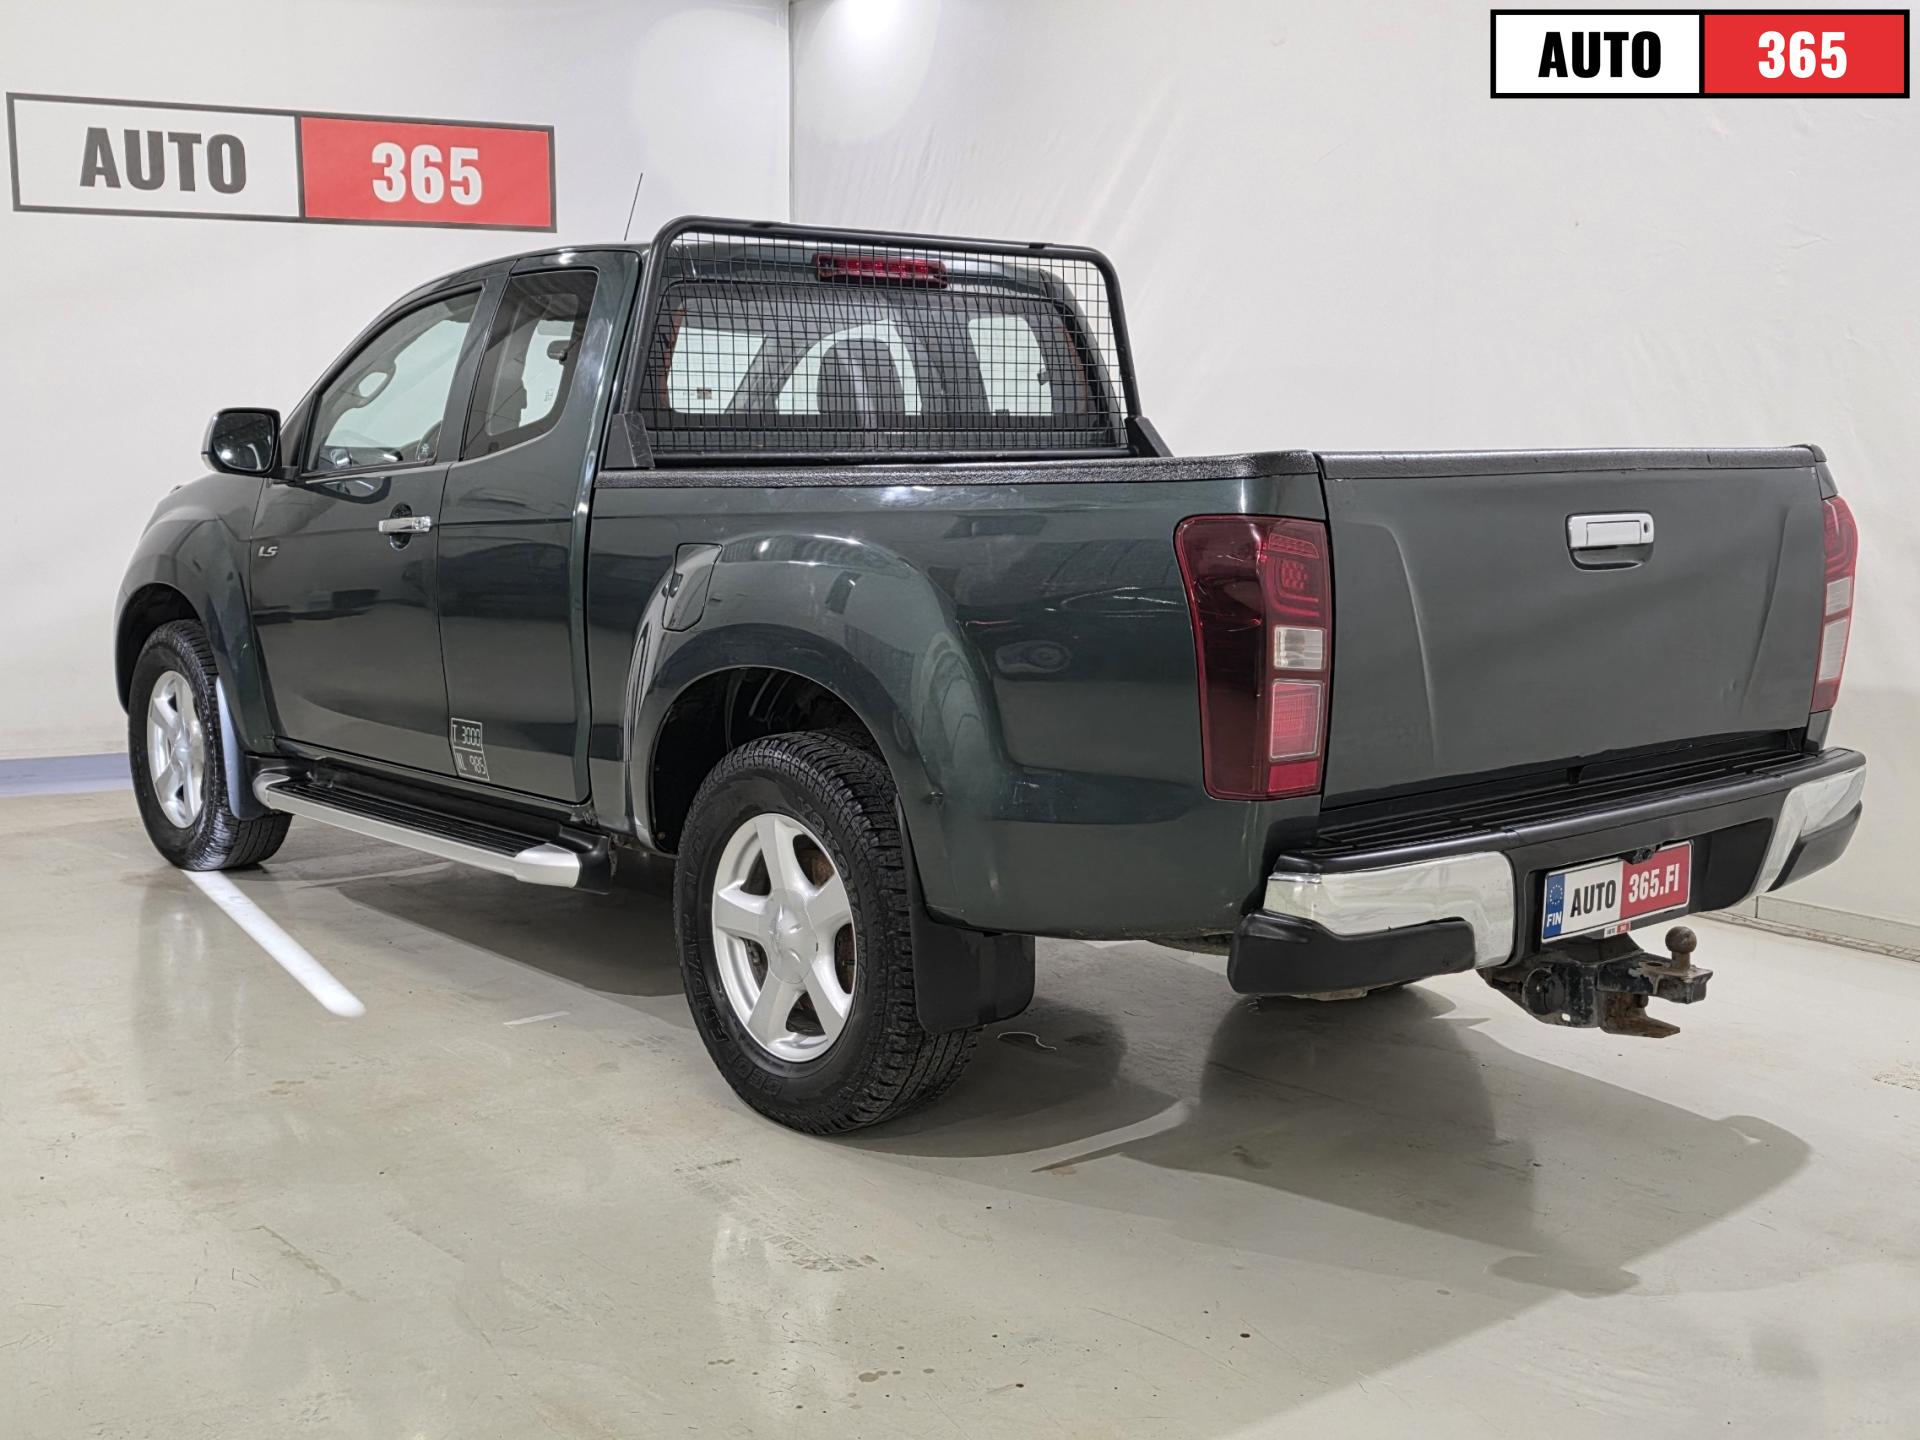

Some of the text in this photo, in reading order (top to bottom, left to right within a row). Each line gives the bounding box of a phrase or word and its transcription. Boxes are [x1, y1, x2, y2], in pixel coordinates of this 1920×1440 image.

[80, 126, 483, 205] AUTO 365
[258, 546, 278, 557] LS
[452, 724, 481, 747] T 3000
[1570, 863, 1681, 918] AUTO 365.FI
[1546, 911, 1563, 928] FIN
